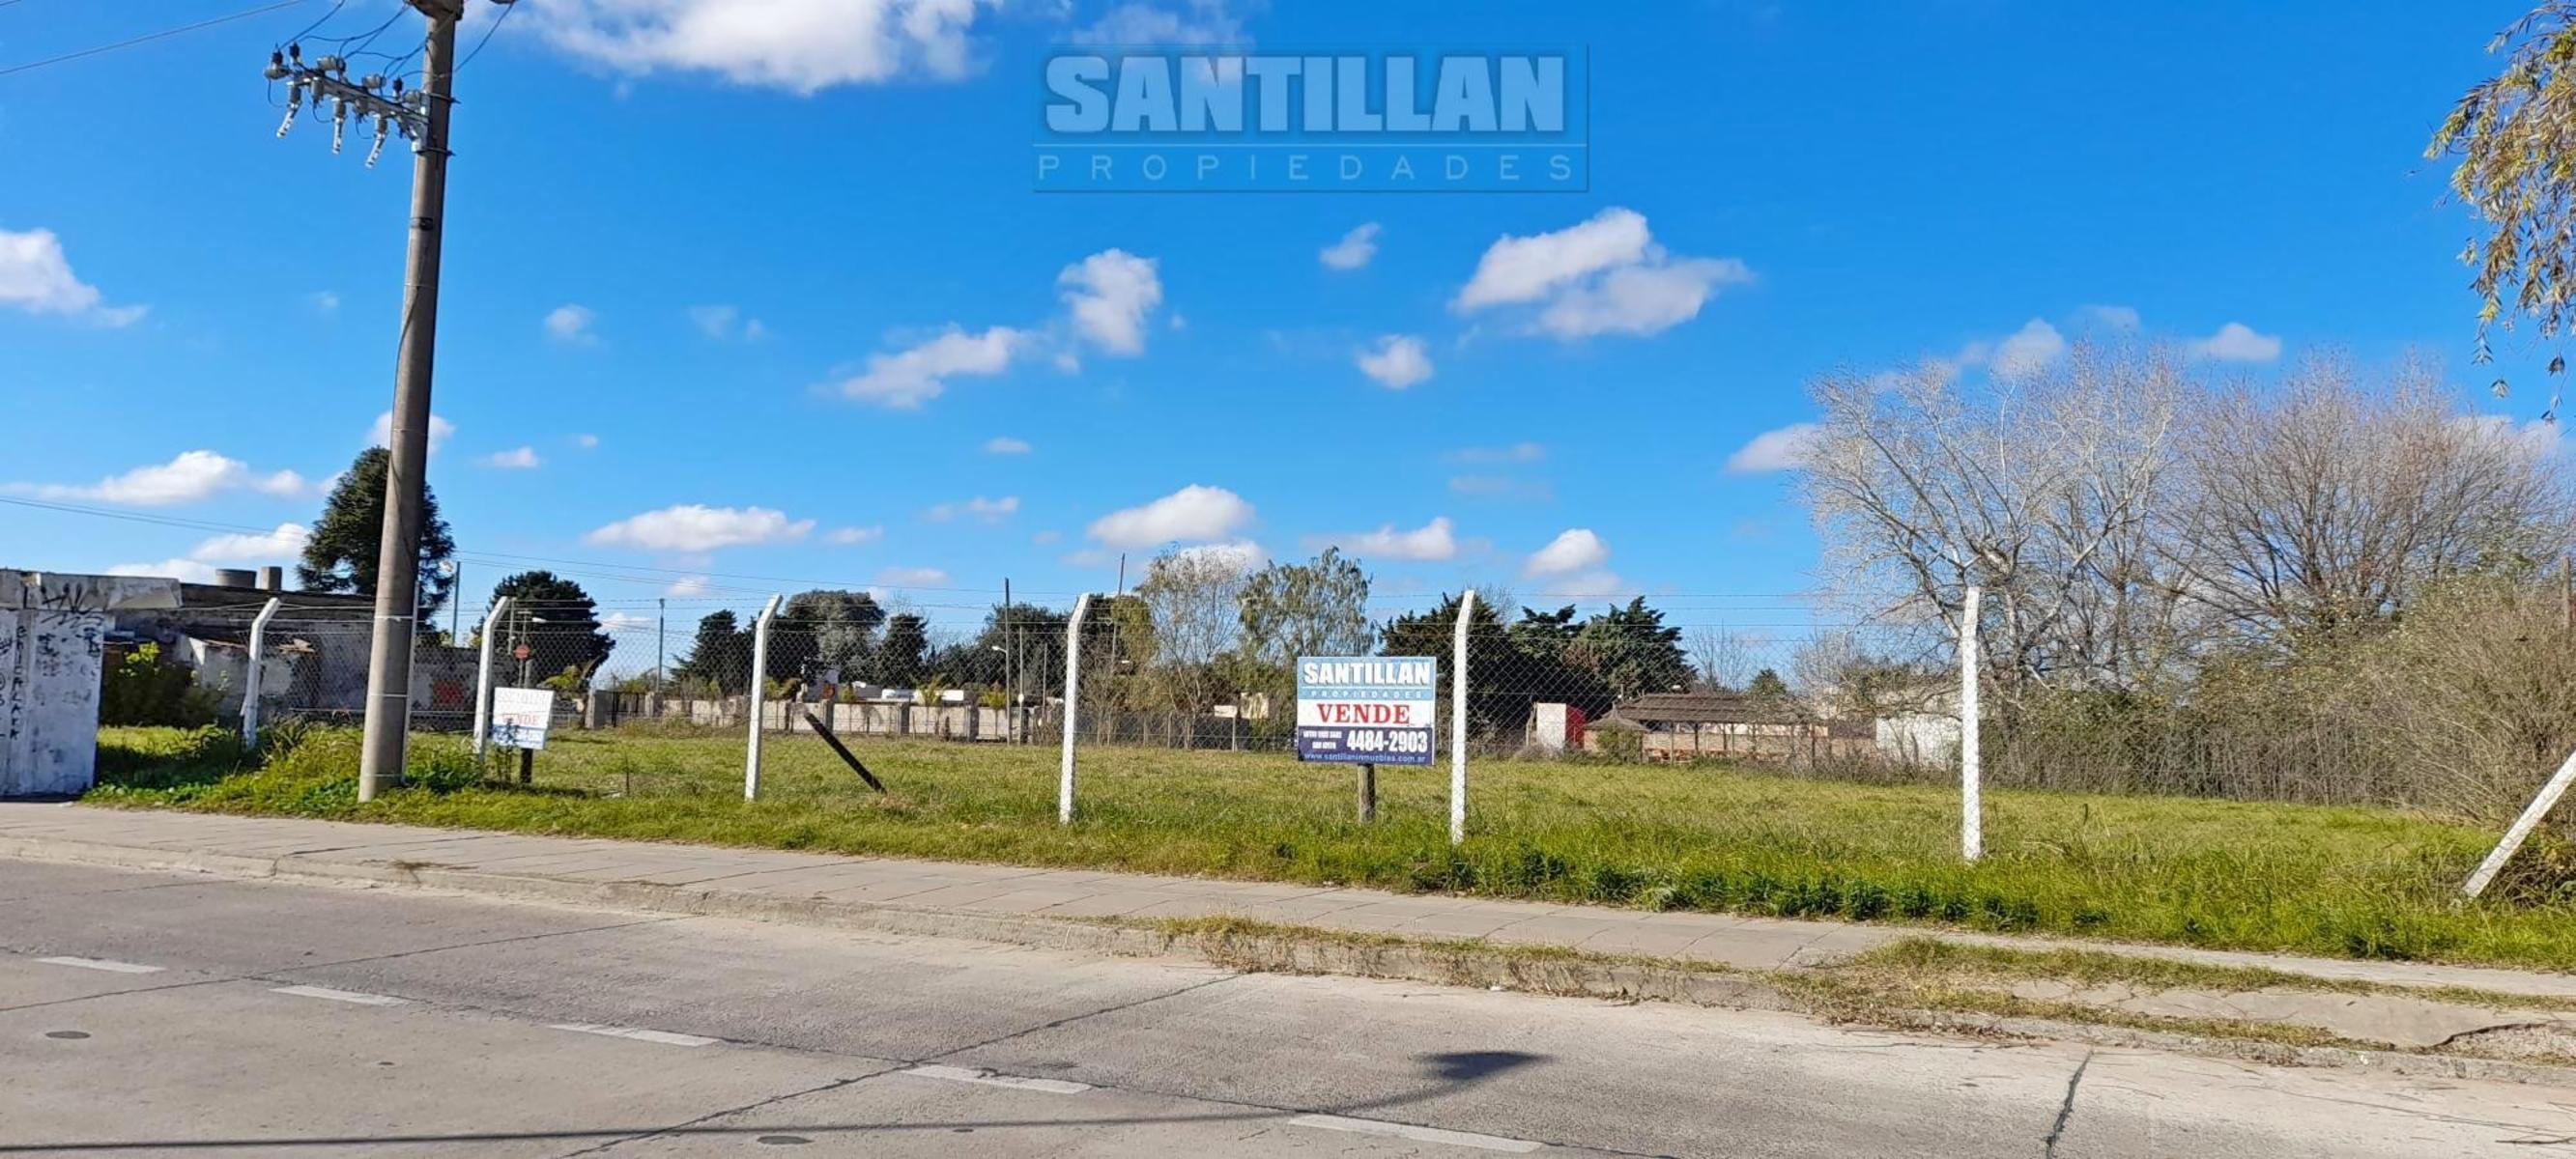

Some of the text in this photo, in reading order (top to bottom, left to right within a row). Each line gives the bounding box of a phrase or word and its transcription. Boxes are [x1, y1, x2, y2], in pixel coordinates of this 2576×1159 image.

[1303, 662, 1431, 686] SANTILLAN
[1310, 689, 1422, 698] PROPIEDADES
[1316, 703, 1411, 724] VENDE
[1346, 729, 1428, 753] 4484-2903
